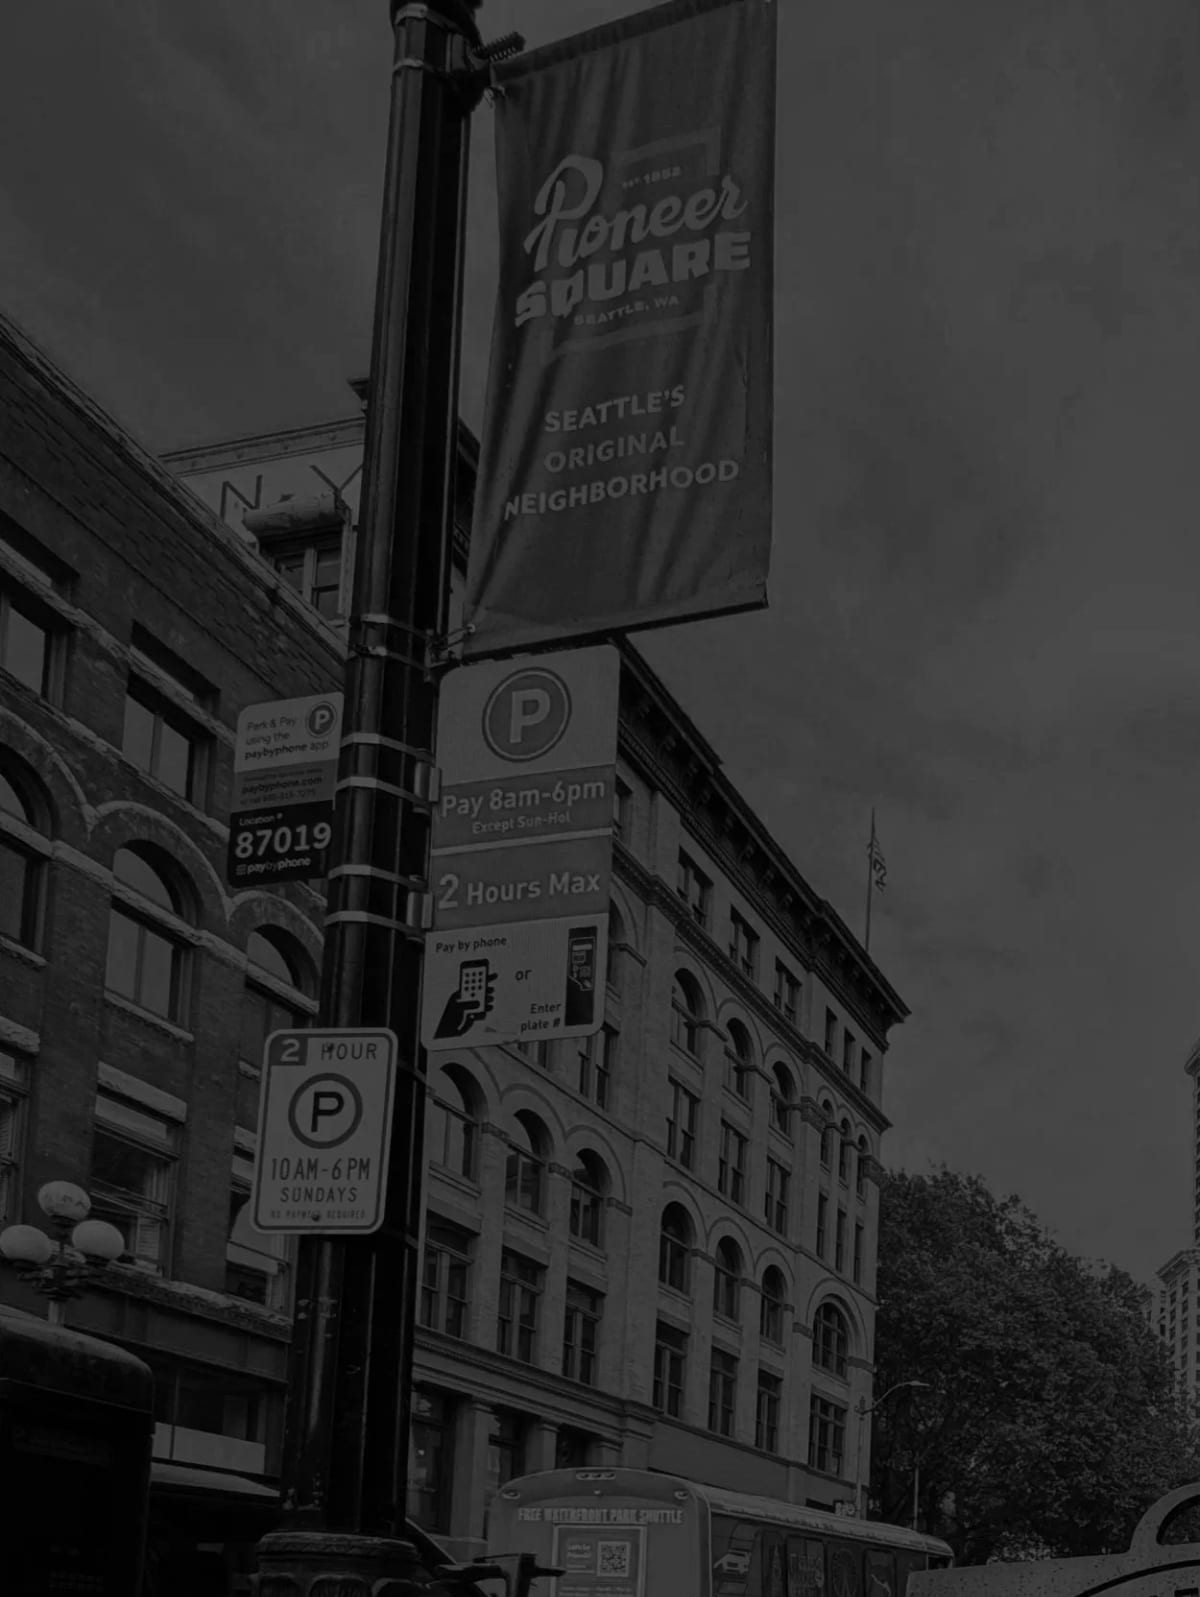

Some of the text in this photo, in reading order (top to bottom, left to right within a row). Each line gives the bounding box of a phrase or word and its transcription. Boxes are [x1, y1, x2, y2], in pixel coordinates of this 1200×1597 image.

[523, 154, 748, 272] Pioneer
[515, 231, 751, 328] SQUARE
[654, 295, 680, 308] WA
[544, 384, 686, 433] SEATTLE'S
[543, 426, 686, 473] ORIGINAL
[504, 459, 740, 521] NEIGHBORHOOD
[273, 731, 291, 741] the
[244, 740, 329, 761] paybyphone app
[441, 780, 606, 818] Pay 8am-6pm
[471, 810, 571, 834] Except Sun-Hol
[234, 822, 332, 859] 87019
[247, 857, 312, 875] paybyphone
[438, 871, 601, 910] 2 Hours Max
[435, 936, 508, 954] Pay by phone
[514, 969, 532, 981] or
[530, 1002, 562, 1015] Enter
[520, 1018, 549, 1032] plate
[279, 1038, 377, 1063] 2 HOUR
[280, 1187, 357, 1203] SUNDAYS
[518, 1507, 683, 1524] FREE WATERFRONT PARK SHUTTLE
